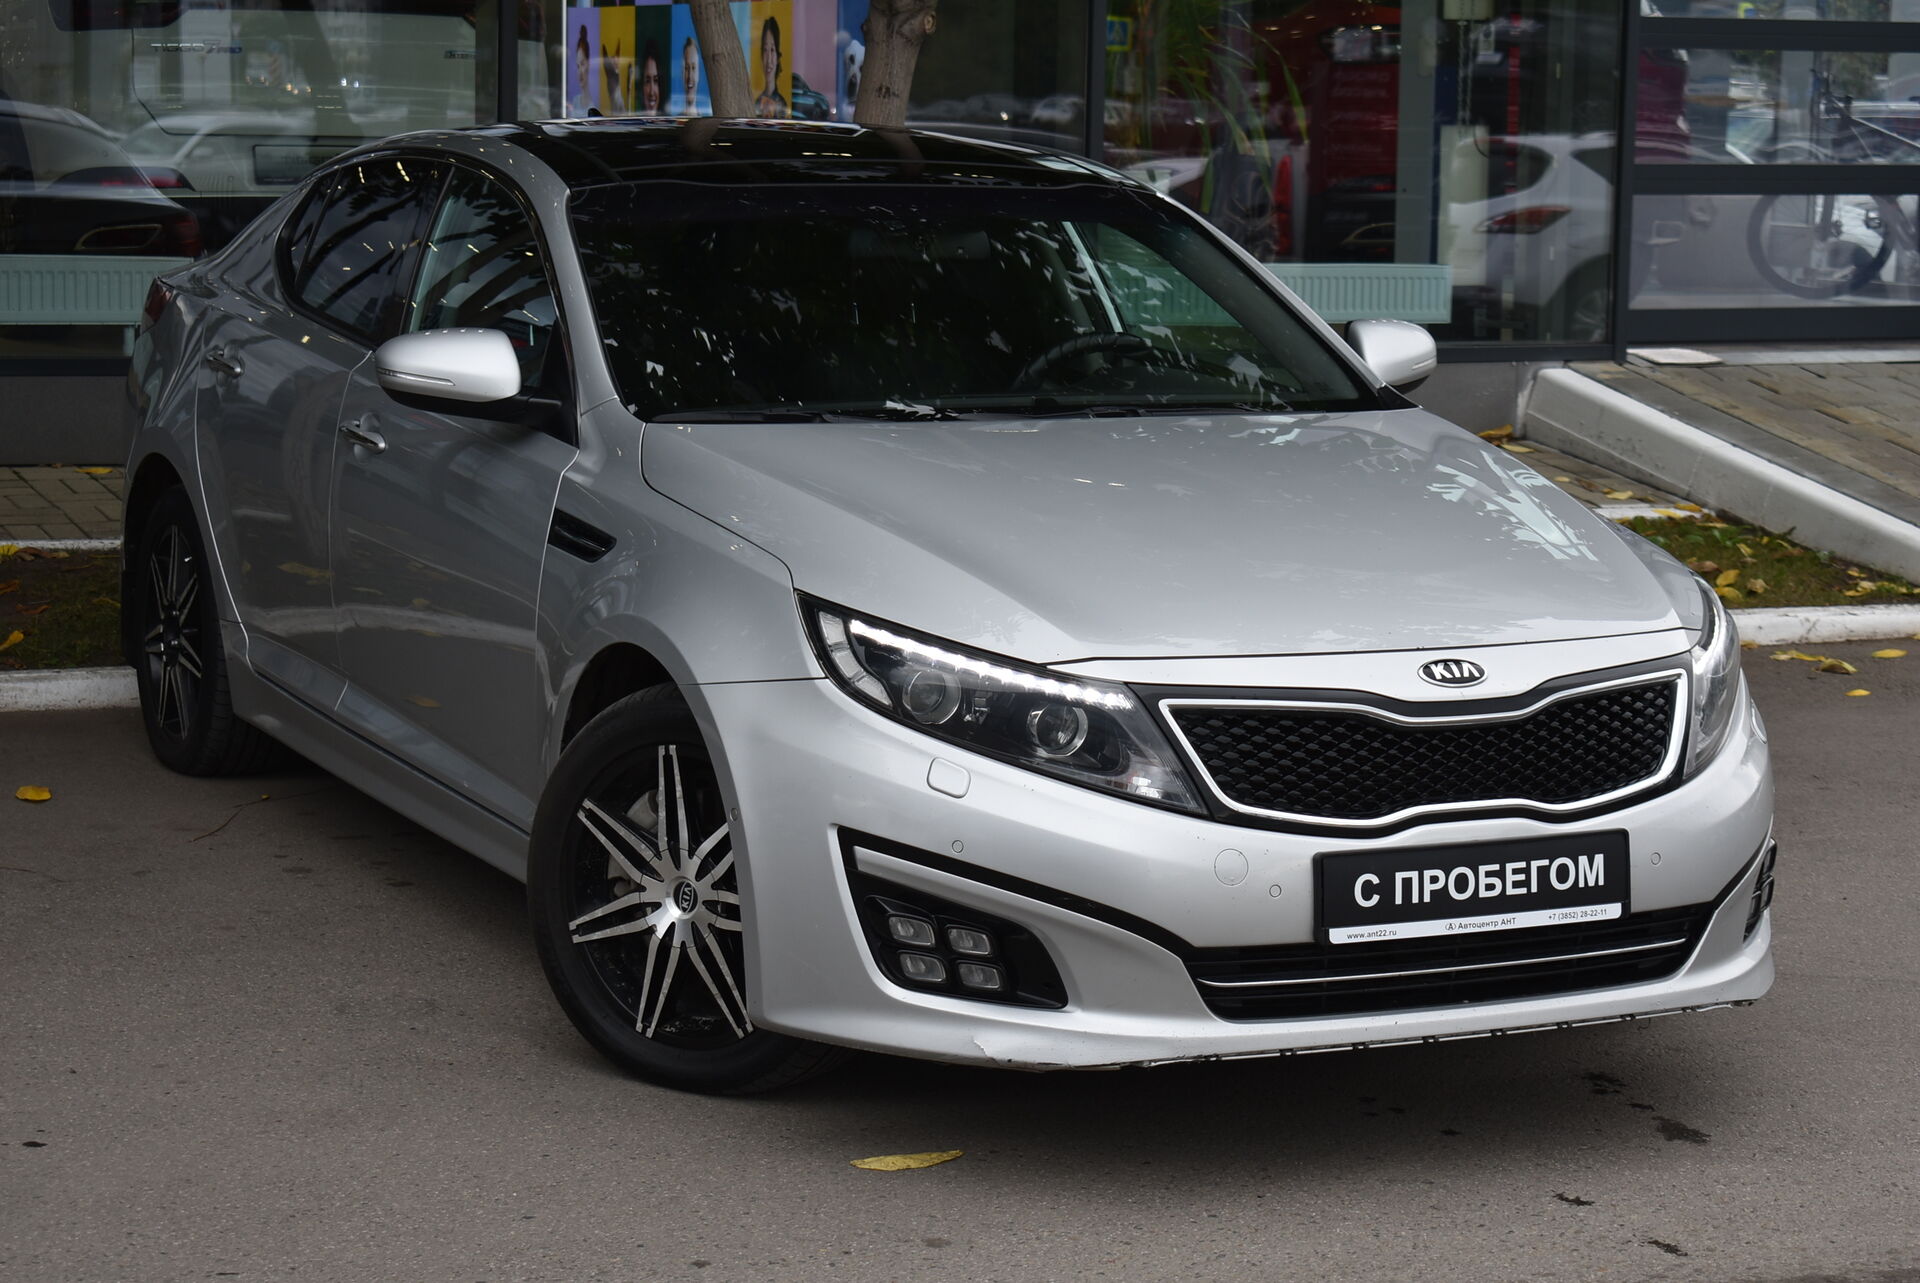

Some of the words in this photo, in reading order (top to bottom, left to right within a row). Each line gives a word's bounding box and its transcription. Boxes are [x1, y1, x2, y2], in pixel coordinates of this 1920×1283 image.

[1428, 661, 1481, 680] KIA
[1353, 873, 1380, 907] С
[1395, 853, 1605, 905] ПРОБЕГОМ
[682, 887, 692, 908] KIA
[1549, 913, 1557, 921] +7
[1559, 911, 1579, 922] (3852)
[1580, 908, 1608, 919] 28-22-11
[1458, 919, 1499, 931] Автоцентр
[1500, 917, 1516, 926] АНТ
[1347, 928, 1397, 940] www.ant22.ru
